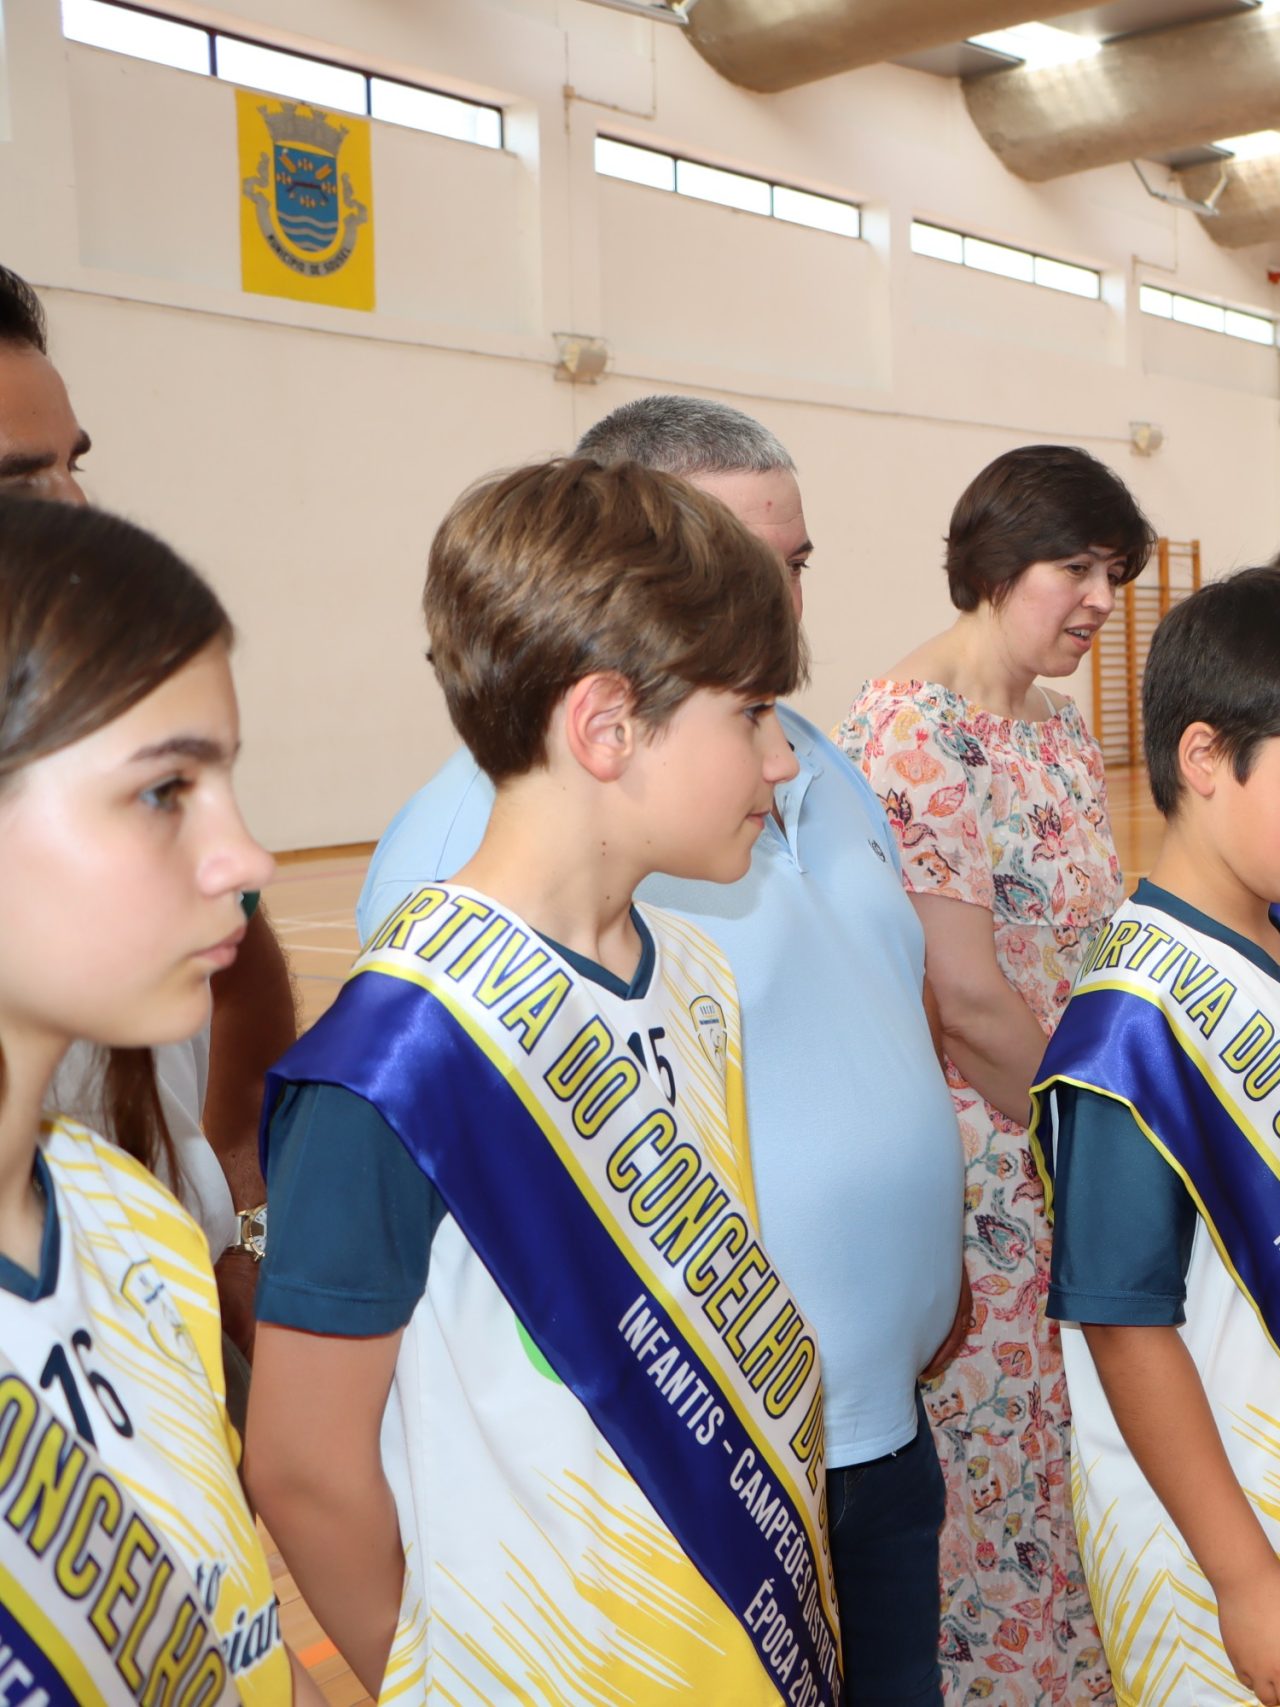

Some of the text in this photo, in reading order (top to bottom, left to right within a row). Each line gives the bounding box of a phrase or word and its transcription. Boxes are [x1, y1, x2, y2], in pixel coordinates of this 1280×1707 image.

[543, 1014, 641, 1140] DO
[606, 1108, 815, 1420] CONCELHO
[618, 1294, 725, 1446] INFANTIS
[729, 1447, 813, 1603] CAMPEÕES
[743, 1577, 800, 1685] ÉPOCA
